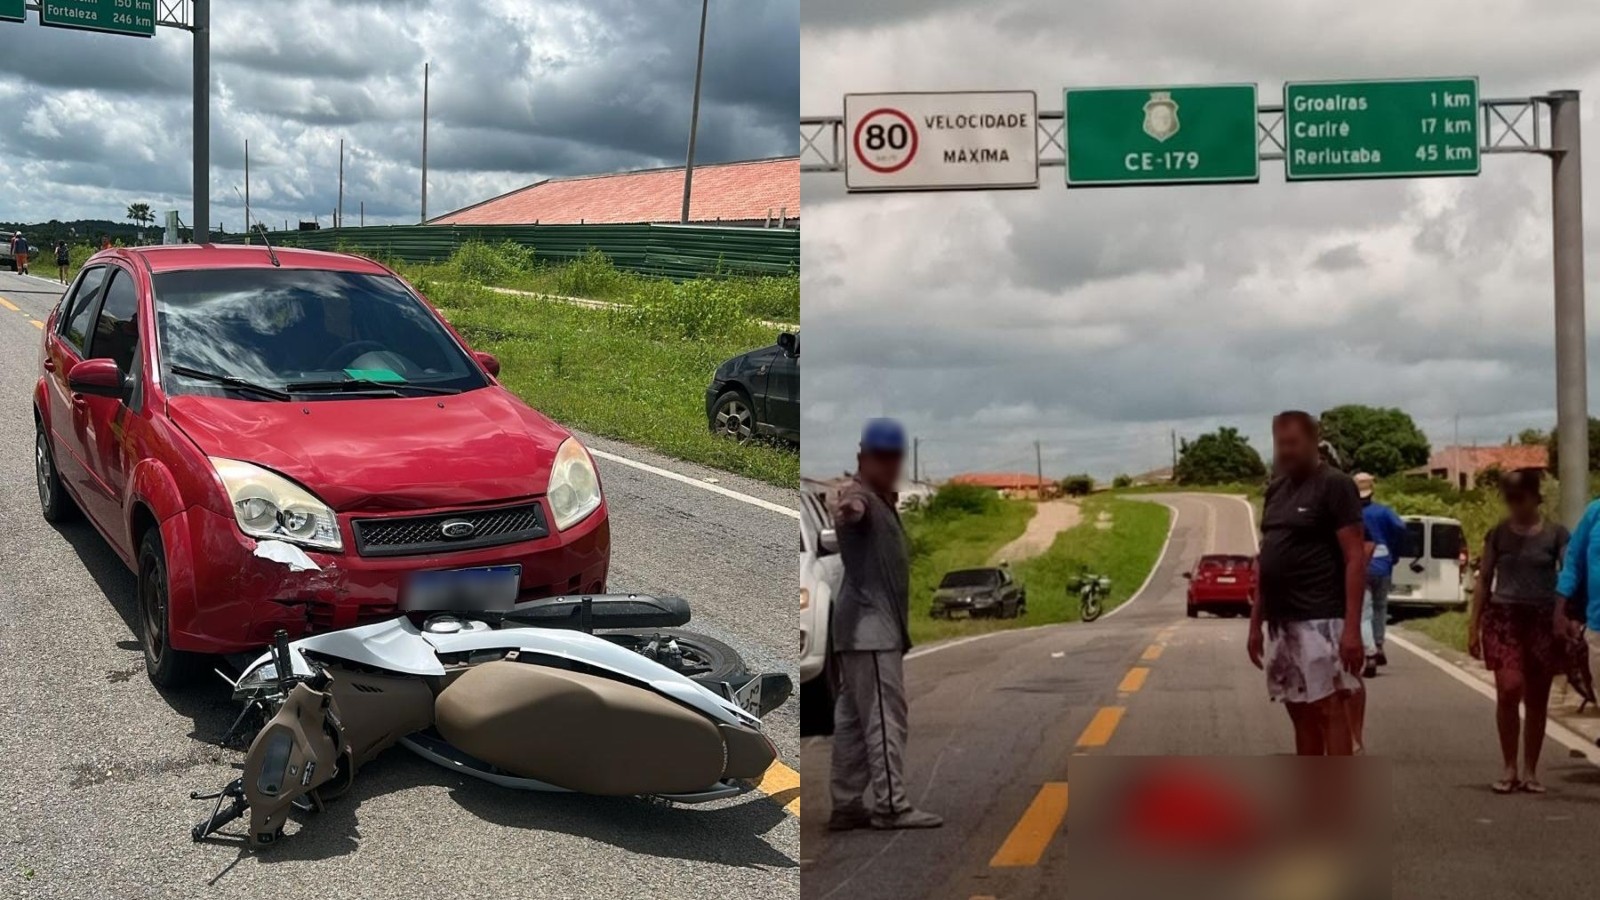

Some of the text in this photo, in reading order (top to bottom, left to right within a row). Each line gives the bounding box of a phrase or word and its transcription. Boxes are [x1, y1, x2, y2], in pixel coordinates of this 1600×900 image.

[135, 0, 151, 10] km
[47, 4, 151, 27] Fortaleza 246 km
[1430, 92, 1437, 107] 1
[1443, 91, 1471, 108] km
[924, 113, 1028, 130] VELOCIDADE
[1421, 118, 1437, 134] 17
[1444, 118, 1472, 134] km
[866, 123, 908, 150] 80
[1294, 144, 1473, 165] Reriutaba 45 km
